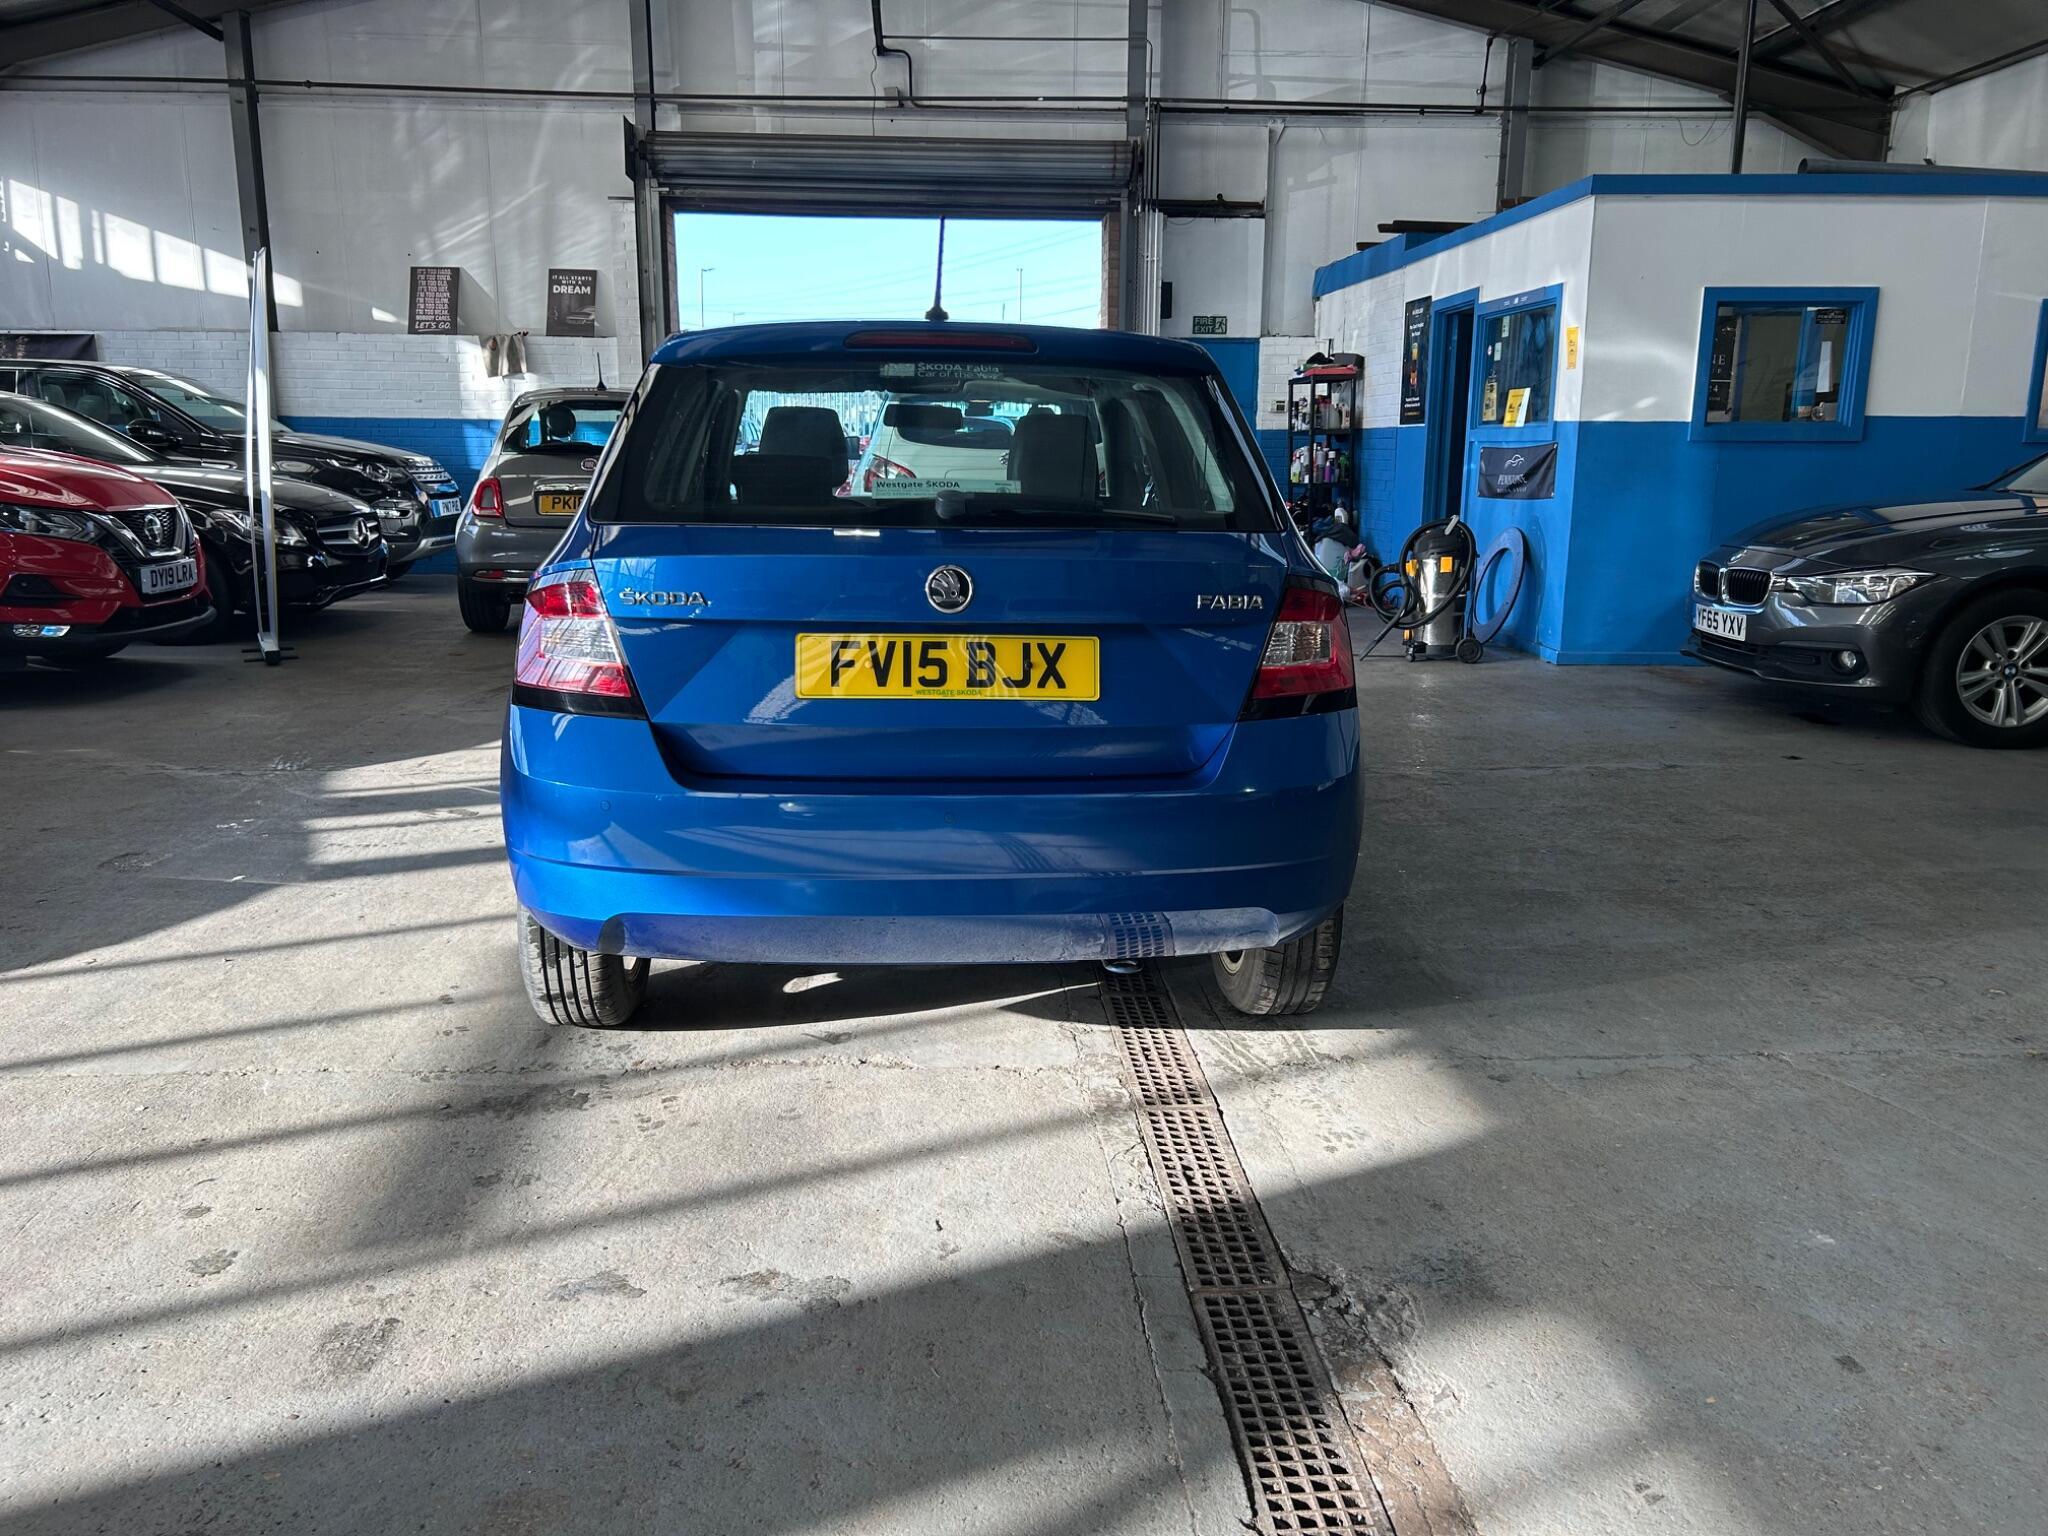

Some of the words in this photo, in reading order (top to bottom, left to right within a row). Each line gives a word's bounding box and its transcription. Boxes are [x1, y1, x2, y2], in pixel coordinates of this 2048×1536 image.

[553, 285, 591, 295] DREAM
[414, 321, 437, 329] LET'S
[876, 481, 924, 489] Westgate
[150, 567, 174, 588] DY19
[176, 564, 194, 584] LRA
[618, 587, 707, 606] ŠKODA
[1197, 594, 1263, 610] FABIA
[1697, 607, 1719, 630] YF65
[1721, 613, 1744, 637] YXV
[830, 640, 949, 687] FV15
[966, 641, 1067, 689] BJX
[915, 688, 955, 697] WESTGATE
